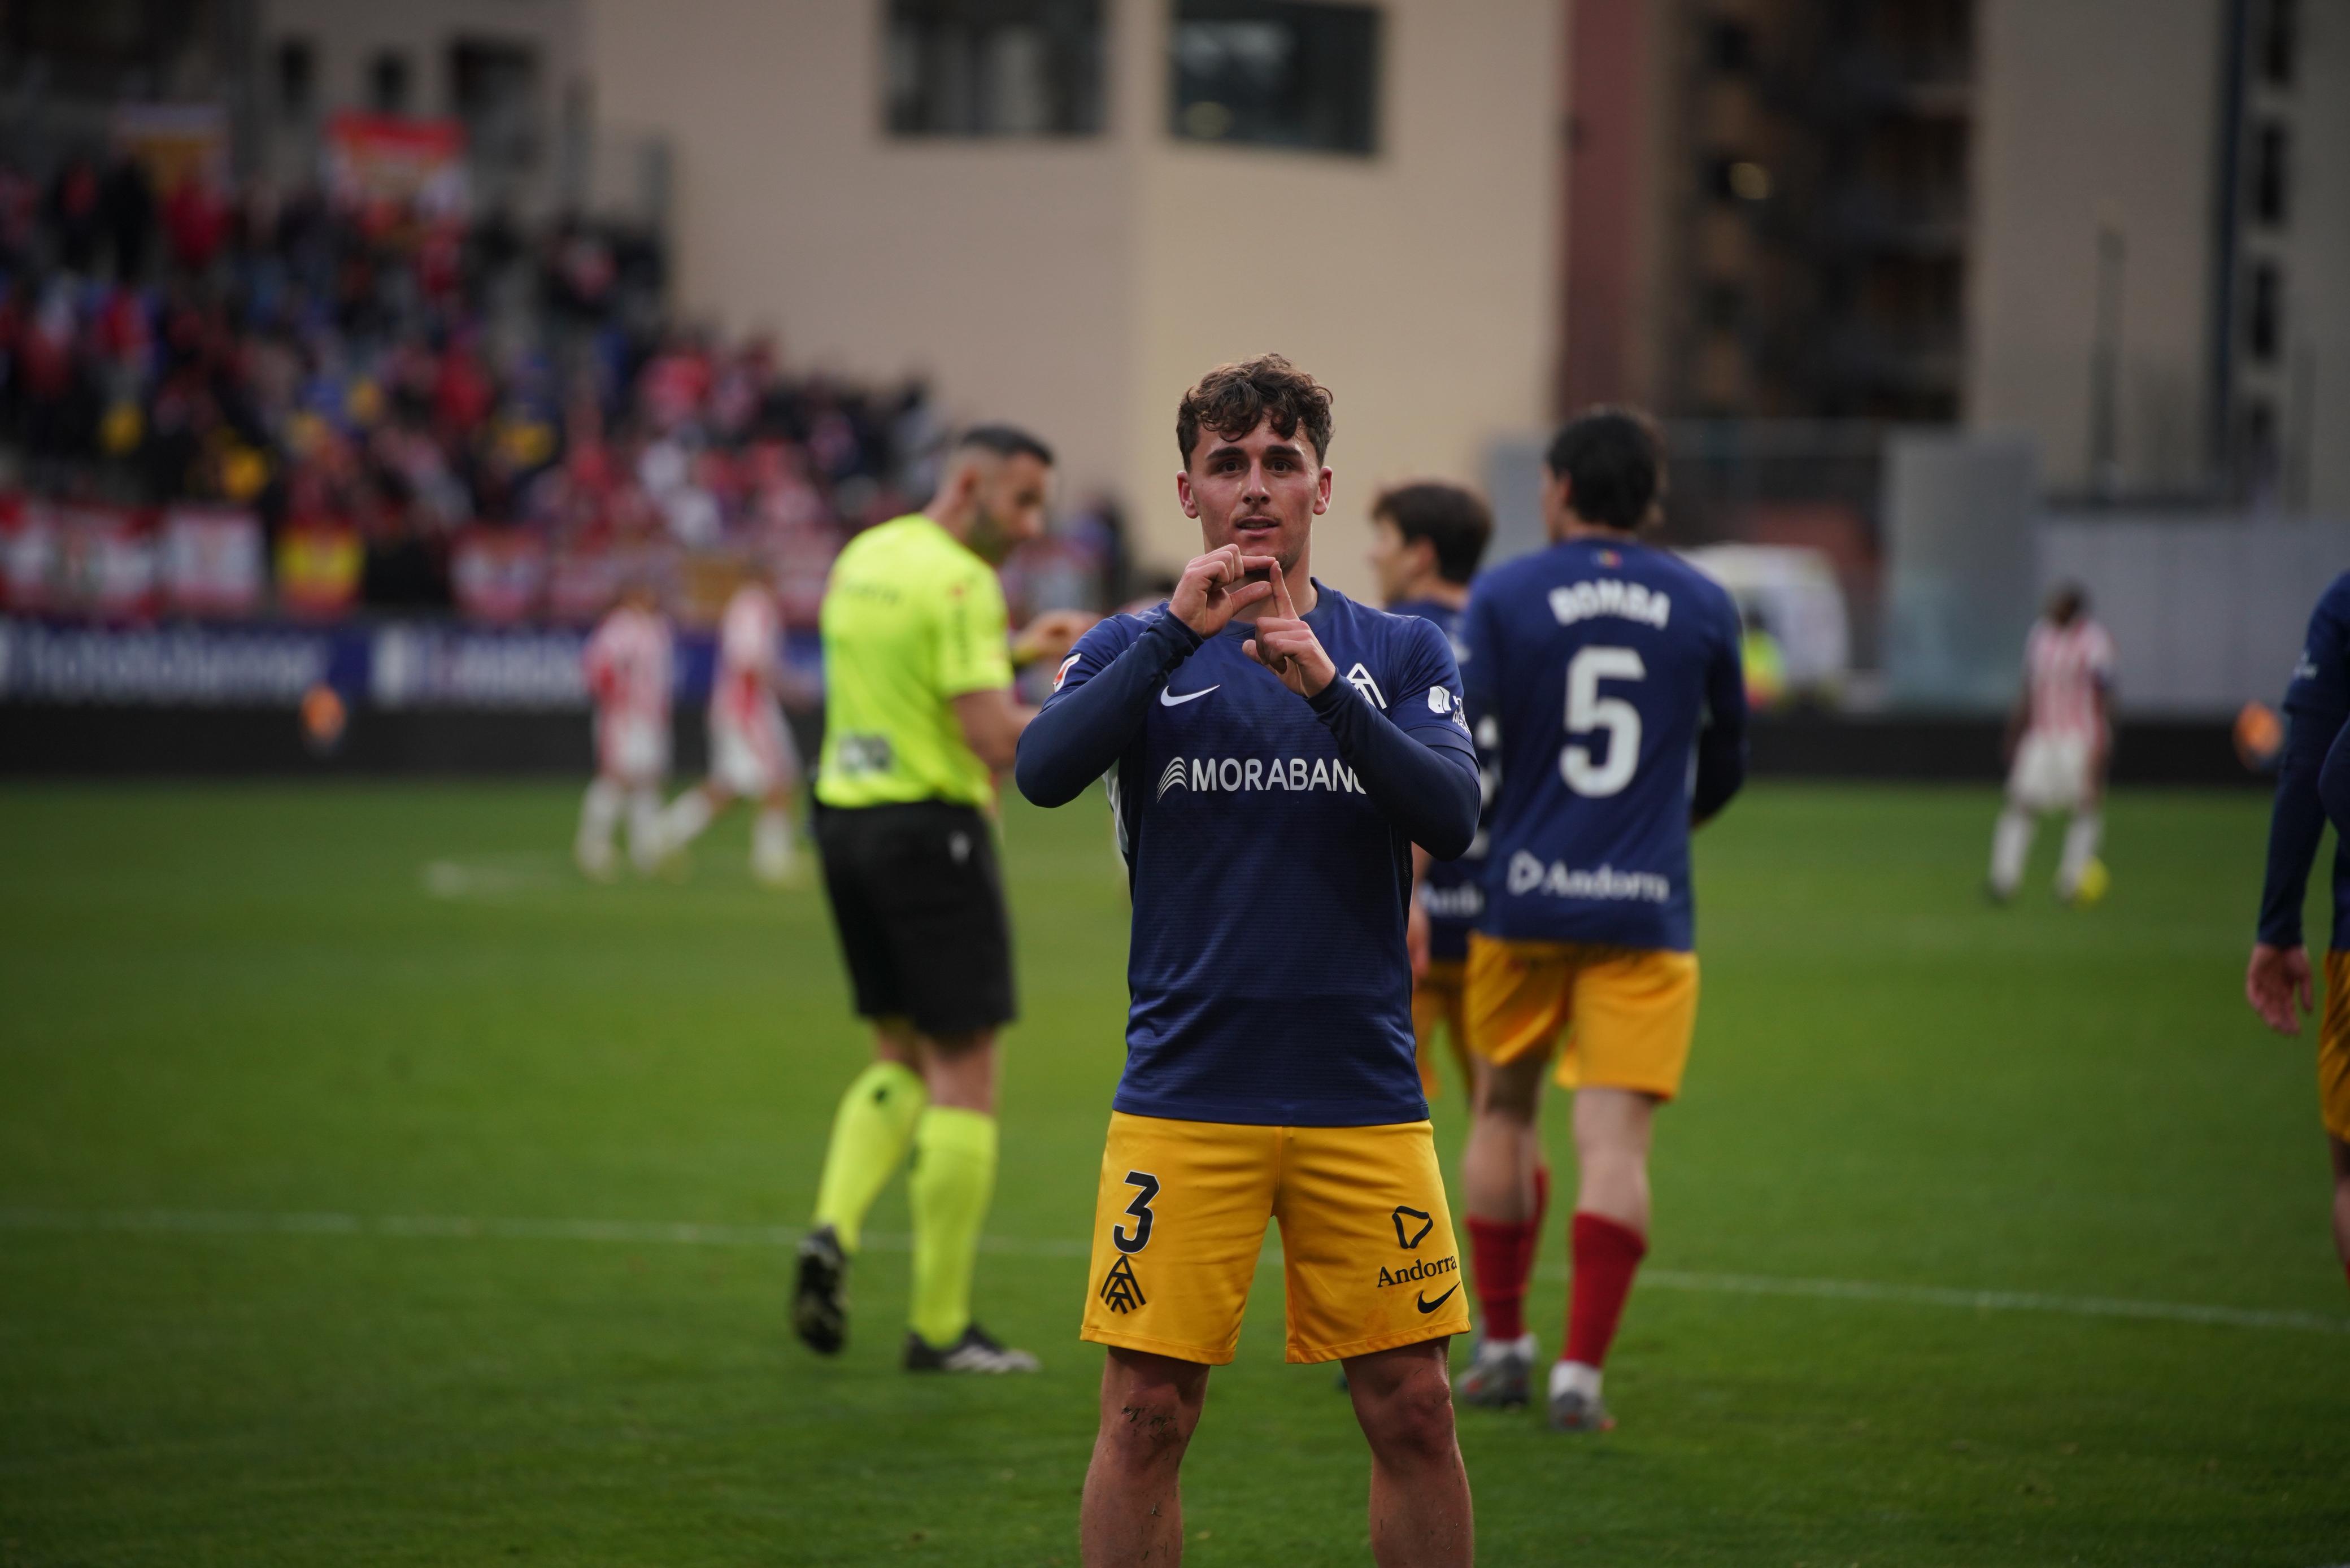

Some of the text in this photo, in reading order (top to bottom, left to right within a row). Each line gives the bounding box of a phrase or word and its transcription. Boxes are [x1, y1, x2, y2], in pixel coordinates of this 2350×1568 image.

[1548, 578, 1670, 630] BOMBA
[1559, 645, 1646, 797] 5
[1112, 1170, 1160, 1254] 3
[1377, 1255, 1457, 1288] Andorra
